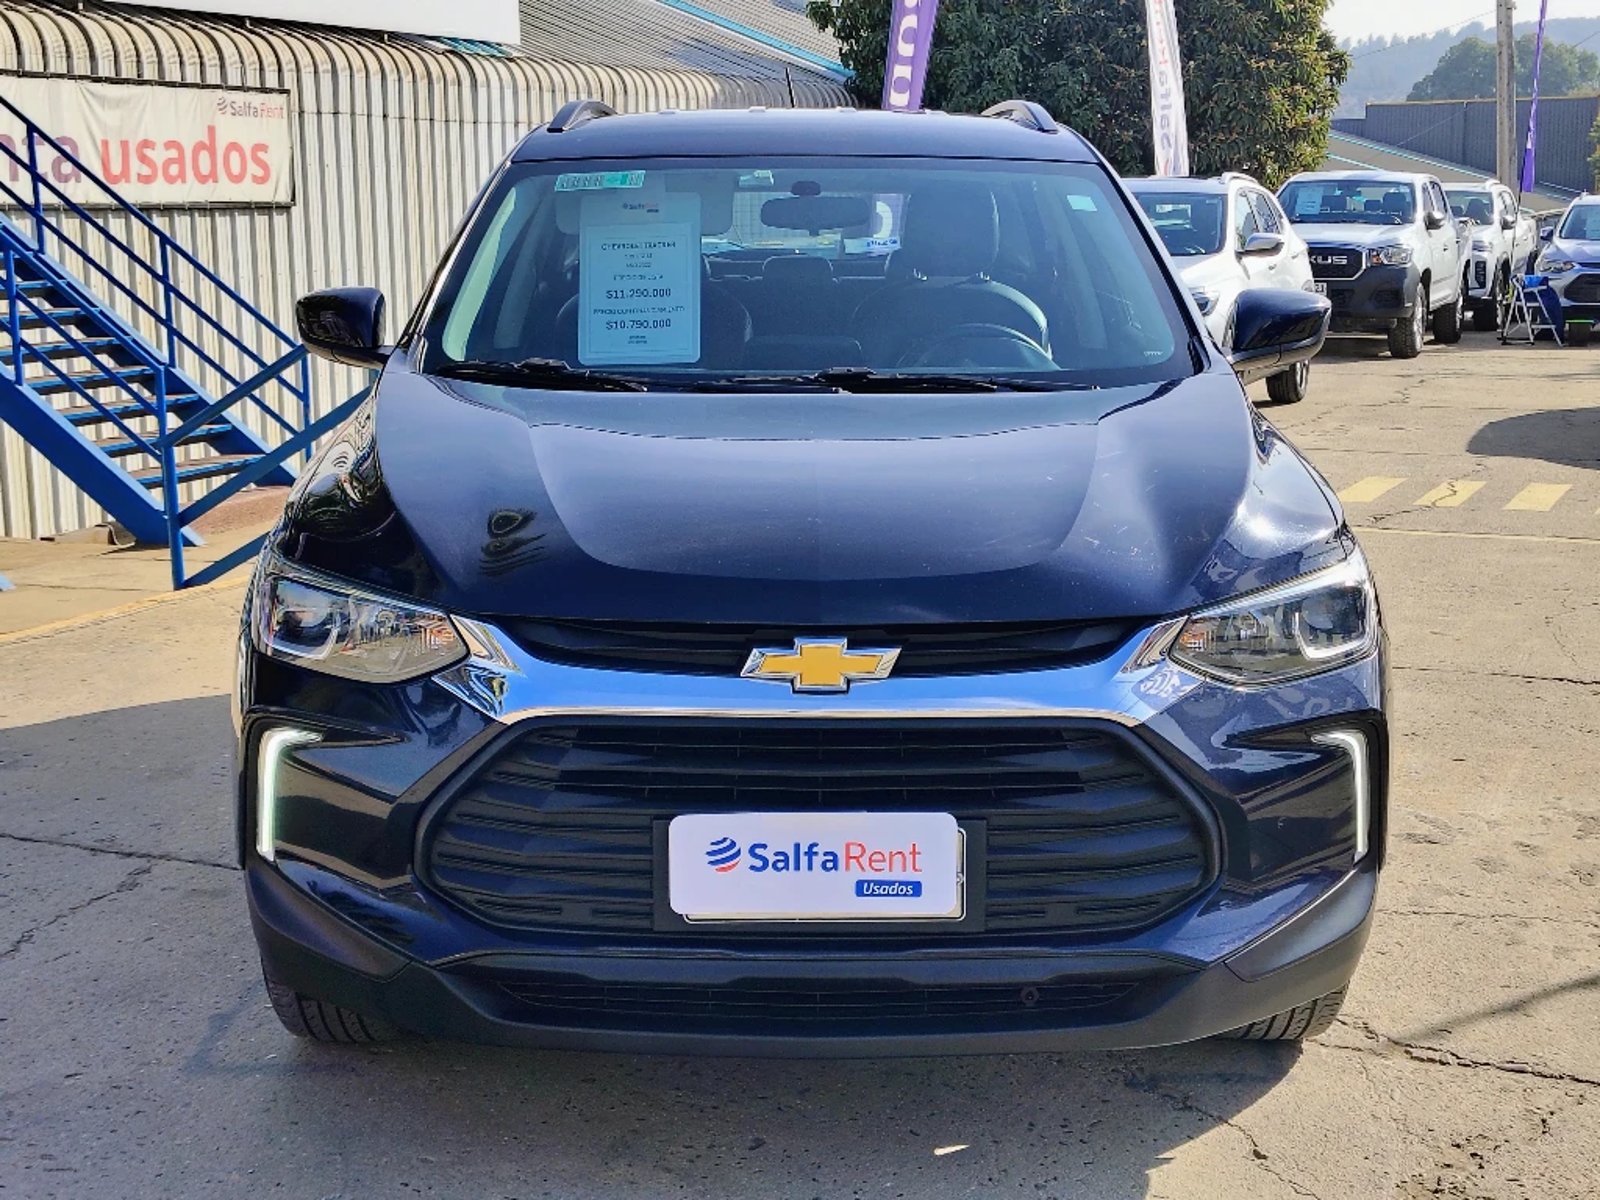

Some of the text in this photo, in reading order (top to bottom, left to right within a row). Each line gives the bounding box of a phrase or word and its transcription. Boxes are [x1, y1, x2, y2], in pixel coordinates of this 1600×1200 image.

[101, 125, 271, 184] usados
[748, 842, 922, 873] SalfaRent
[863, 882, 913, 896] Usados
